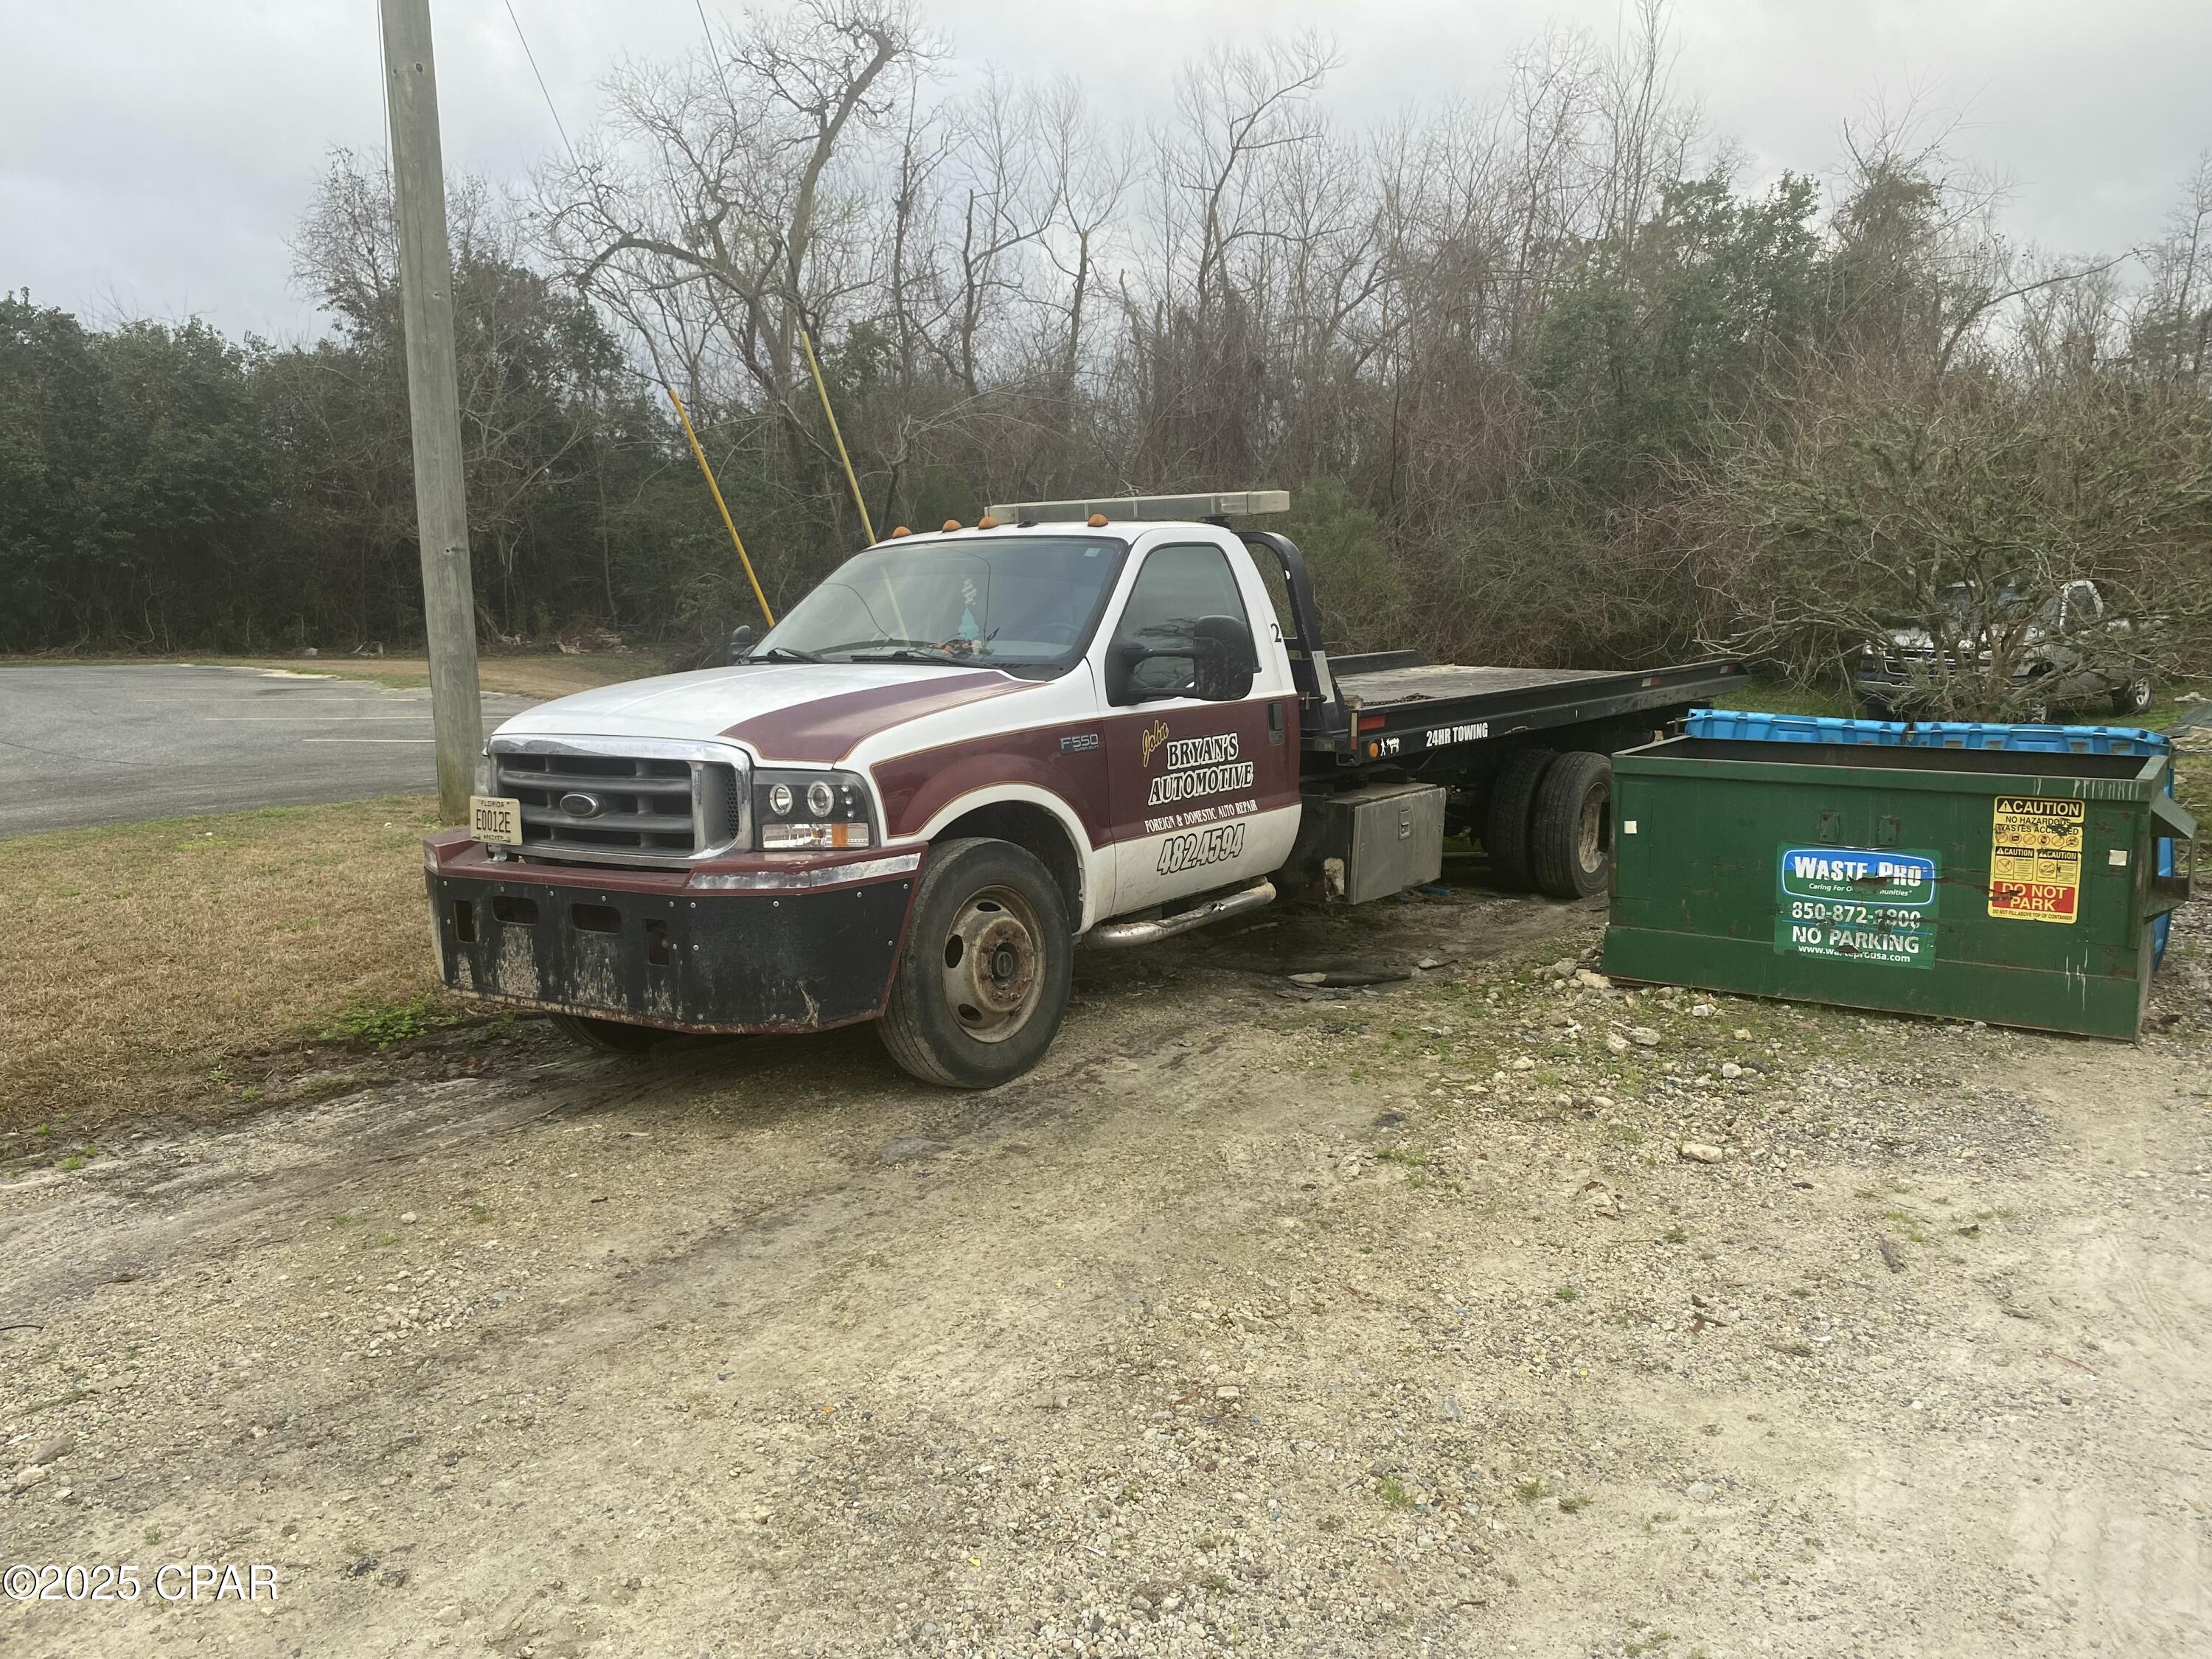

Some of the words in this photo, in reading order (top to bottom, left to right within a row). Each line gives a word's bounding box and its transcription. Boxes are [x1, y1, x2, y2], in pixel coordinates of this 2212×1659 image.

[1270, 623, 1282, 643] 2
[1142, 720, 1169, 767] John
[1426, 728, 1451, 747] 24HR
[1453, 722, 1488, 742] TOWING
[1167, 732, 1239, 769] BRYAN'S
[1148, 761, 1253, 805] AUTOMOTIVE
[481, 800, 505, 808] FLORIDA
[2013, 800, 2079, 816] CAUTION
[476, 808, 511, 833] E0012E
[1144, 815, 1176, 833] FOREIGN
[1177, 814, 1183, 827] &
[1183, 807, 1217, 825] DOMESTIC
[1218, 804, 1234, 818] AUTO
[1235, 799, 1258, 815] REPAIR
[2020, 816, 2071, 827] HAZARDOUS
[1997, 824, 2032, 833] WASTES
[2034, 827, 2079, 835] ACCED
[2004, 847, 2034, 858] CAUTION
[2047, 850, 2077, 860] CAUTION
[1794, 856, 1868, 882] WASTE
[1879, 861, 1921, 887] PRO
[1809, 883, 1832, 892] Caring
[2002, 883, 2026, 897] DO
[2031, 885, 2067, 900] NOT
[2010, 896, 2056, 911] PARK
[1792, 925, 1822, 945] NO
[1829, 928, 1920, 954] PARKING
[1798, 945, 1911, 963] www.wateprousa.com
